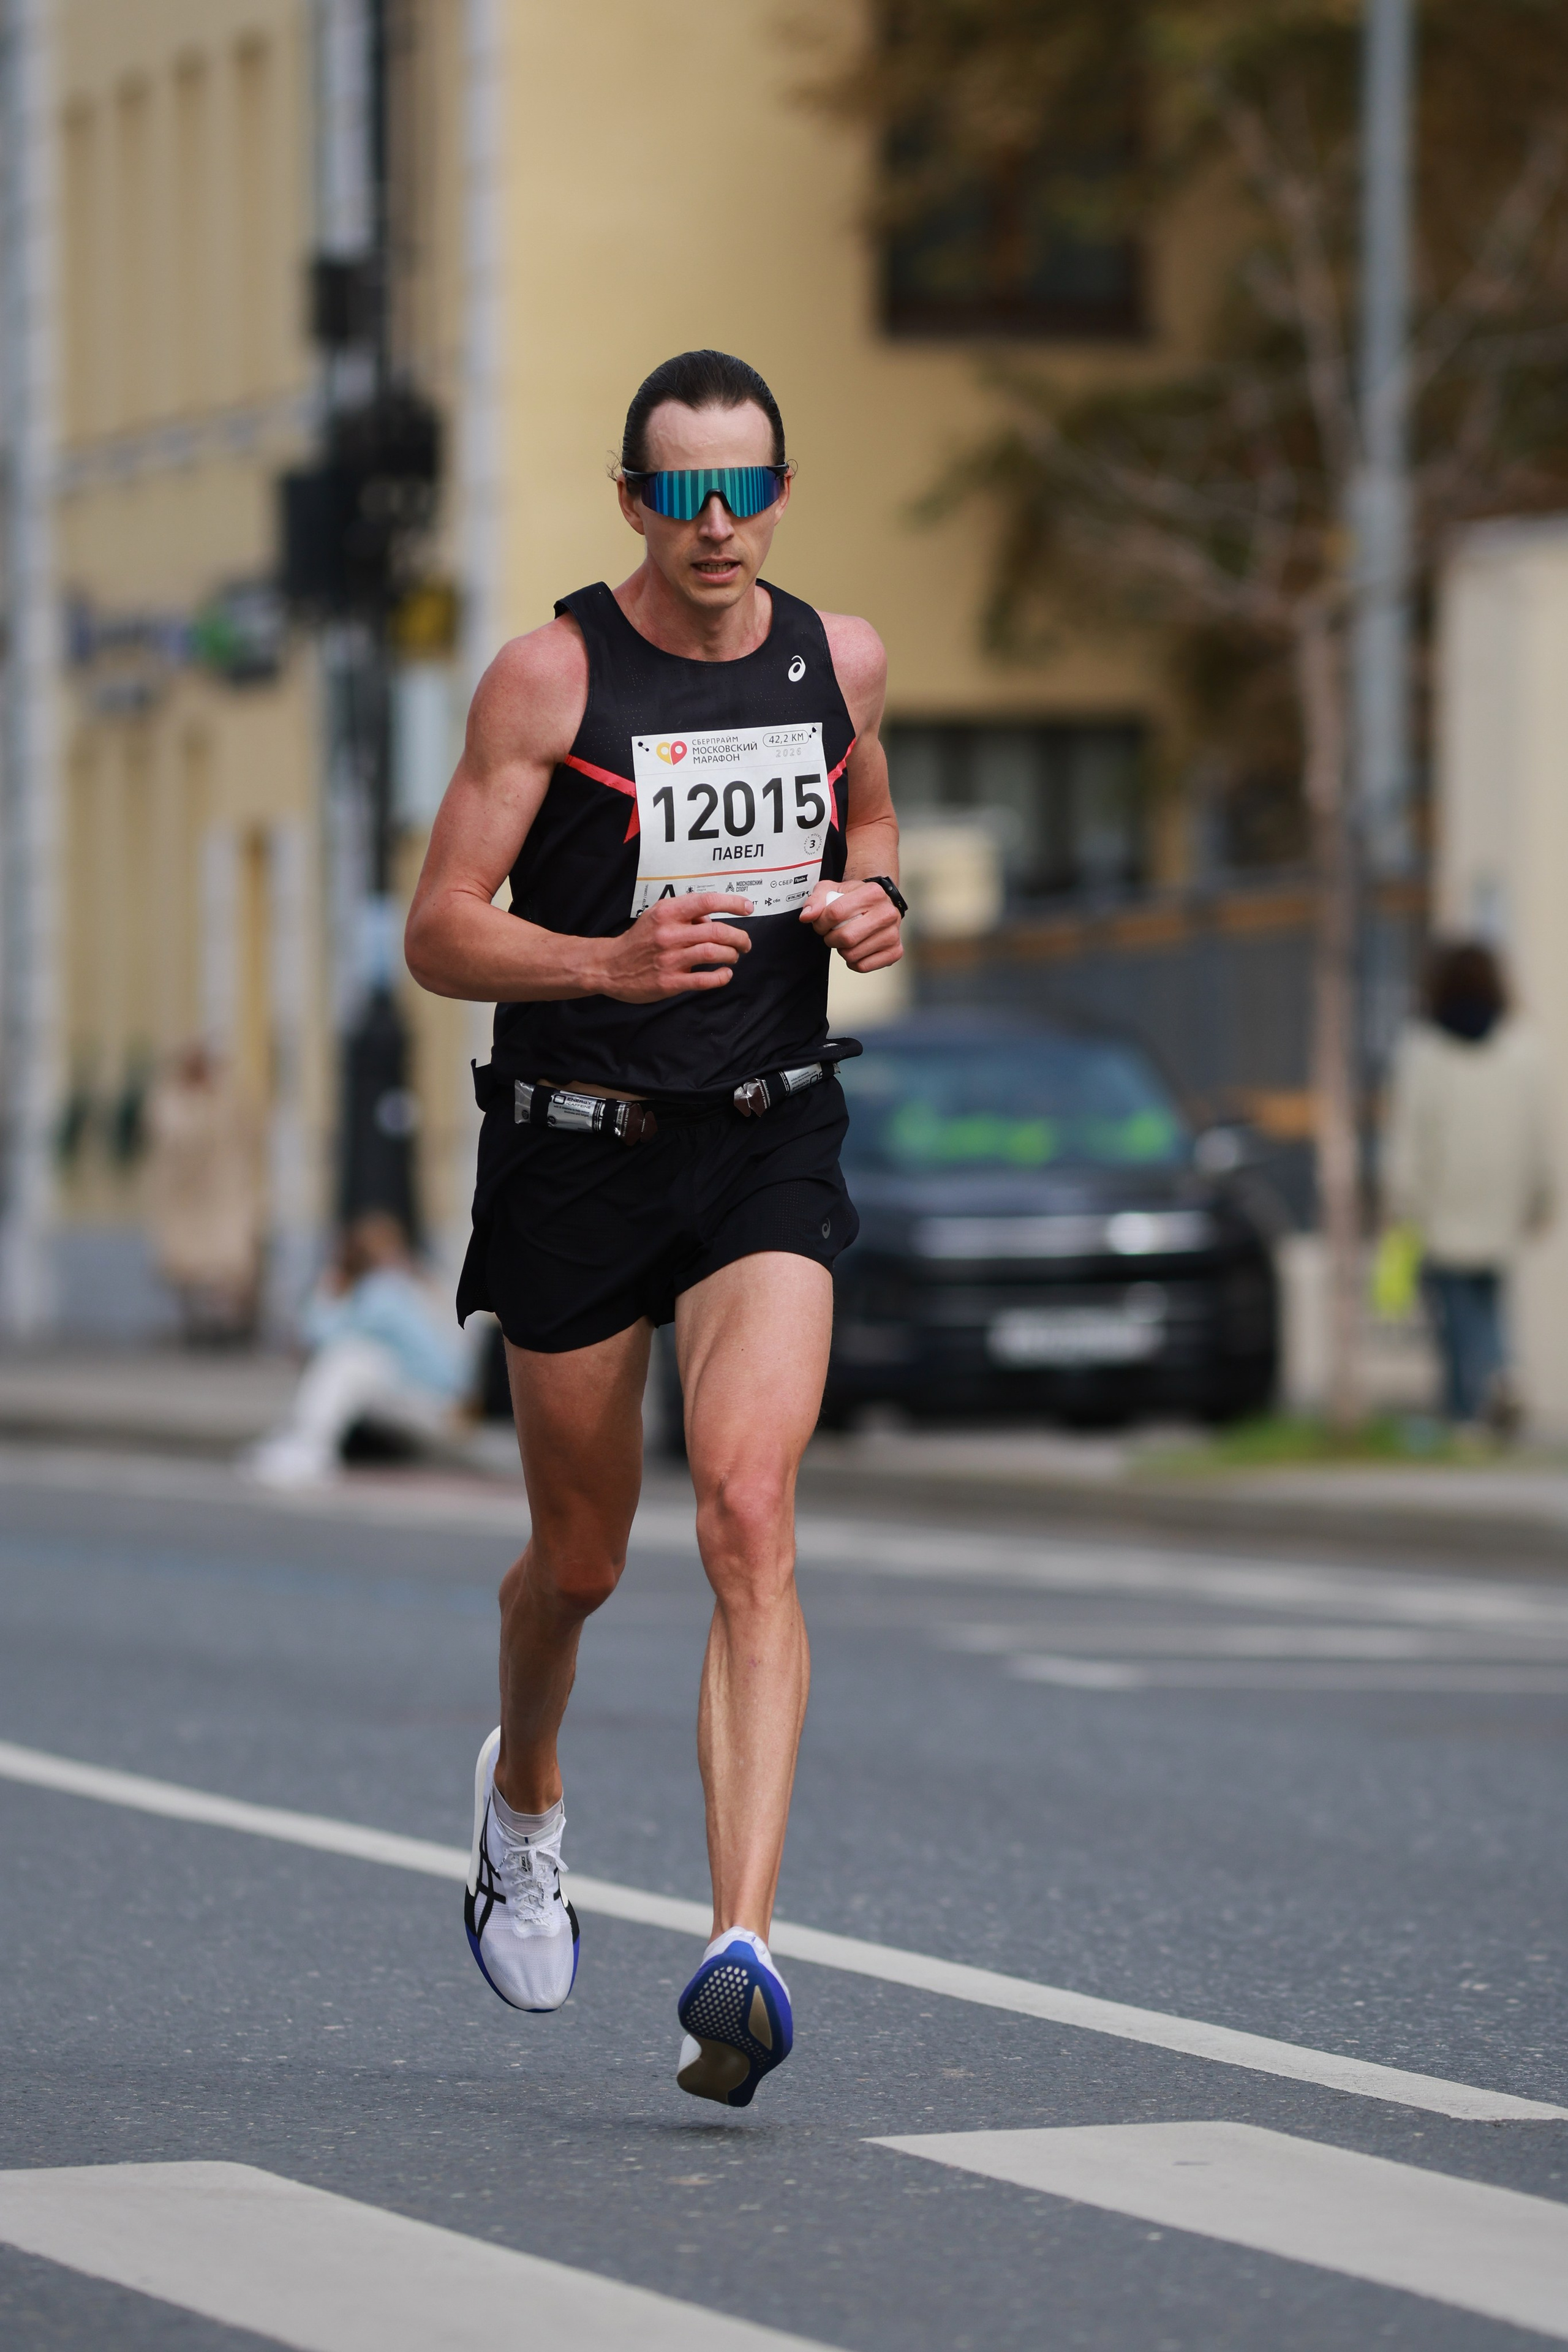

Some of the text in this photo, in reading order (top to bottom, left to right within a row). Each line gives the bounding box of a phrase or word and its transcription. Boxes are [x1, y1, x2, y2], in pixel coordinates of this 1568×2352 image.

[692, 736, 739, 745] СБЕРПРАЙМ
[769, 734, 788, 744] 42,2
[692, 741, 758, 755] МОСКОВСКИЙ
[693, 753, 741, 764] МАРАФОН
[652, 773, 826, 843] 12015
[809, 840, 816, 848] 3
[712, 843, 764, 861] ПАВЕЛ
